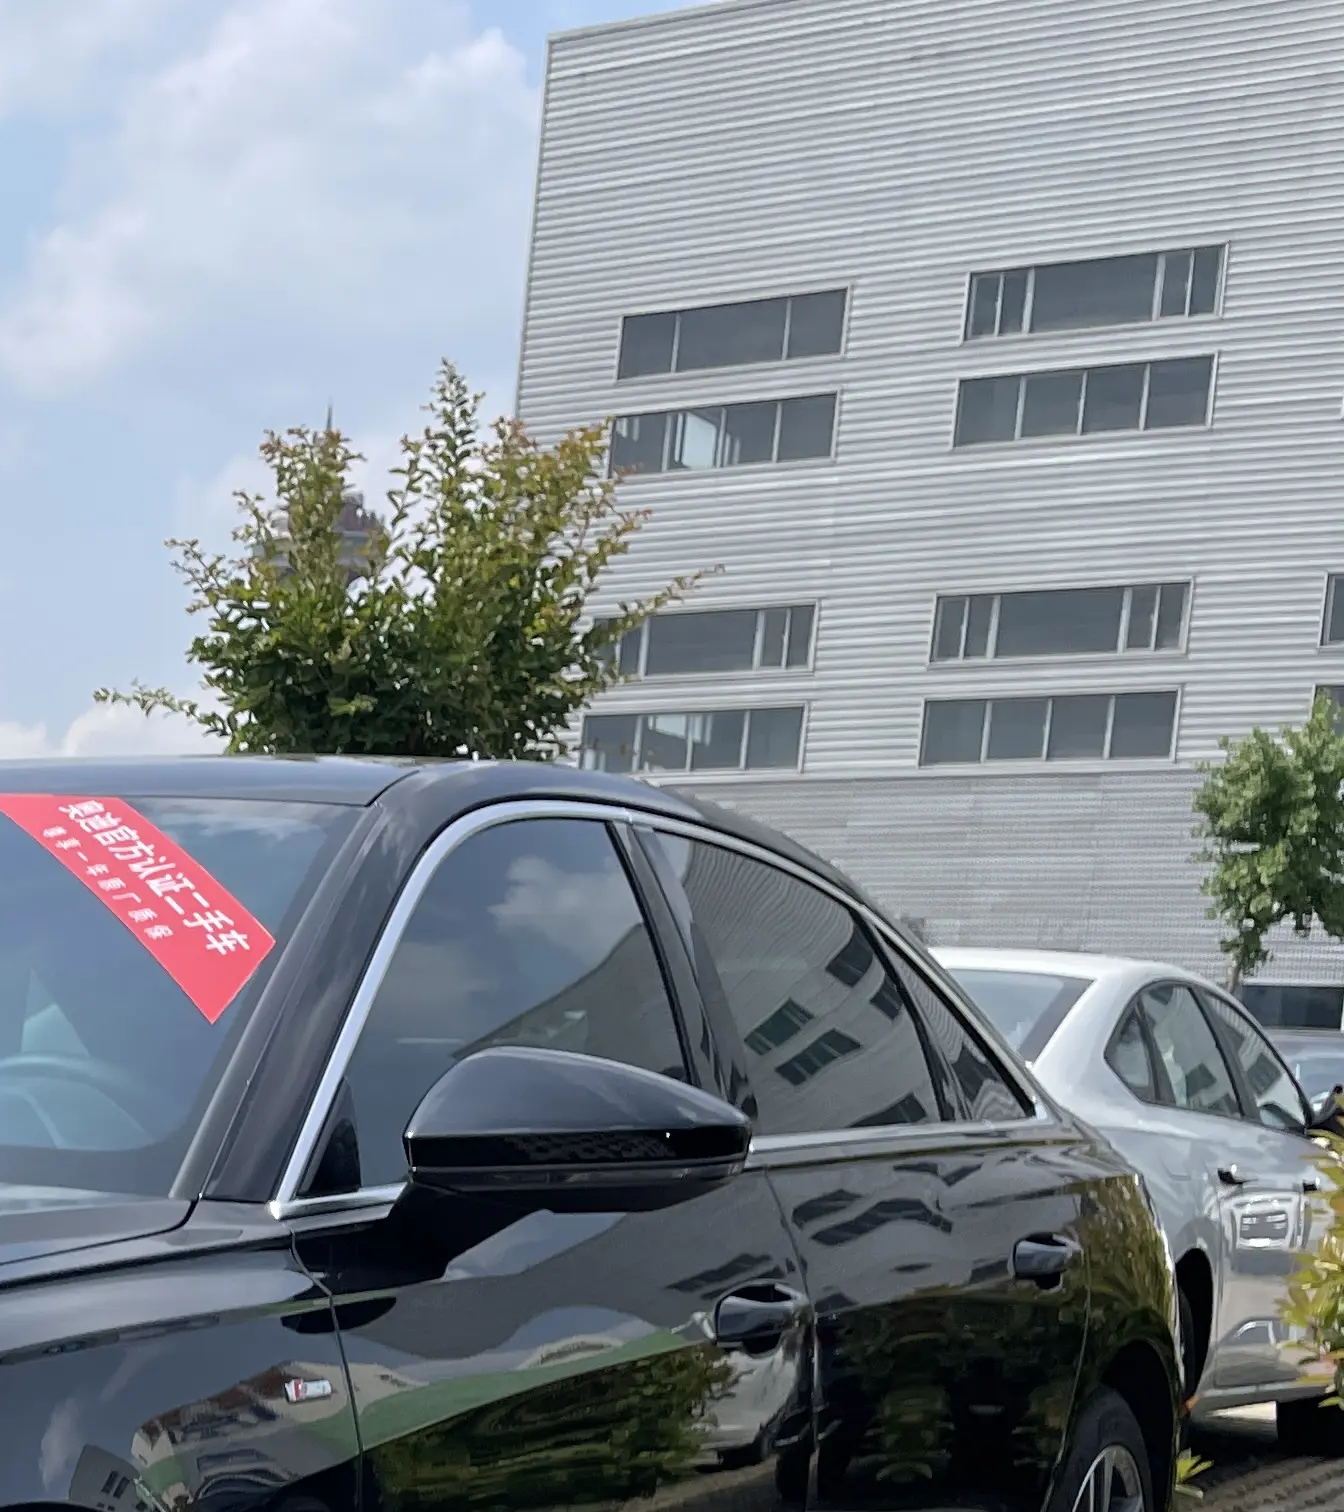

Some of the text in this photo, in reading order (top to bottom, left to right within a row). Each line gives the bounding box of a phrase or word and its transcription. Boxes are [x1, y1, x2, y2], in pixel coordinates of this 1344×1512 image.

[58, 800, 251, 956] 奥迪官方认证二手车
